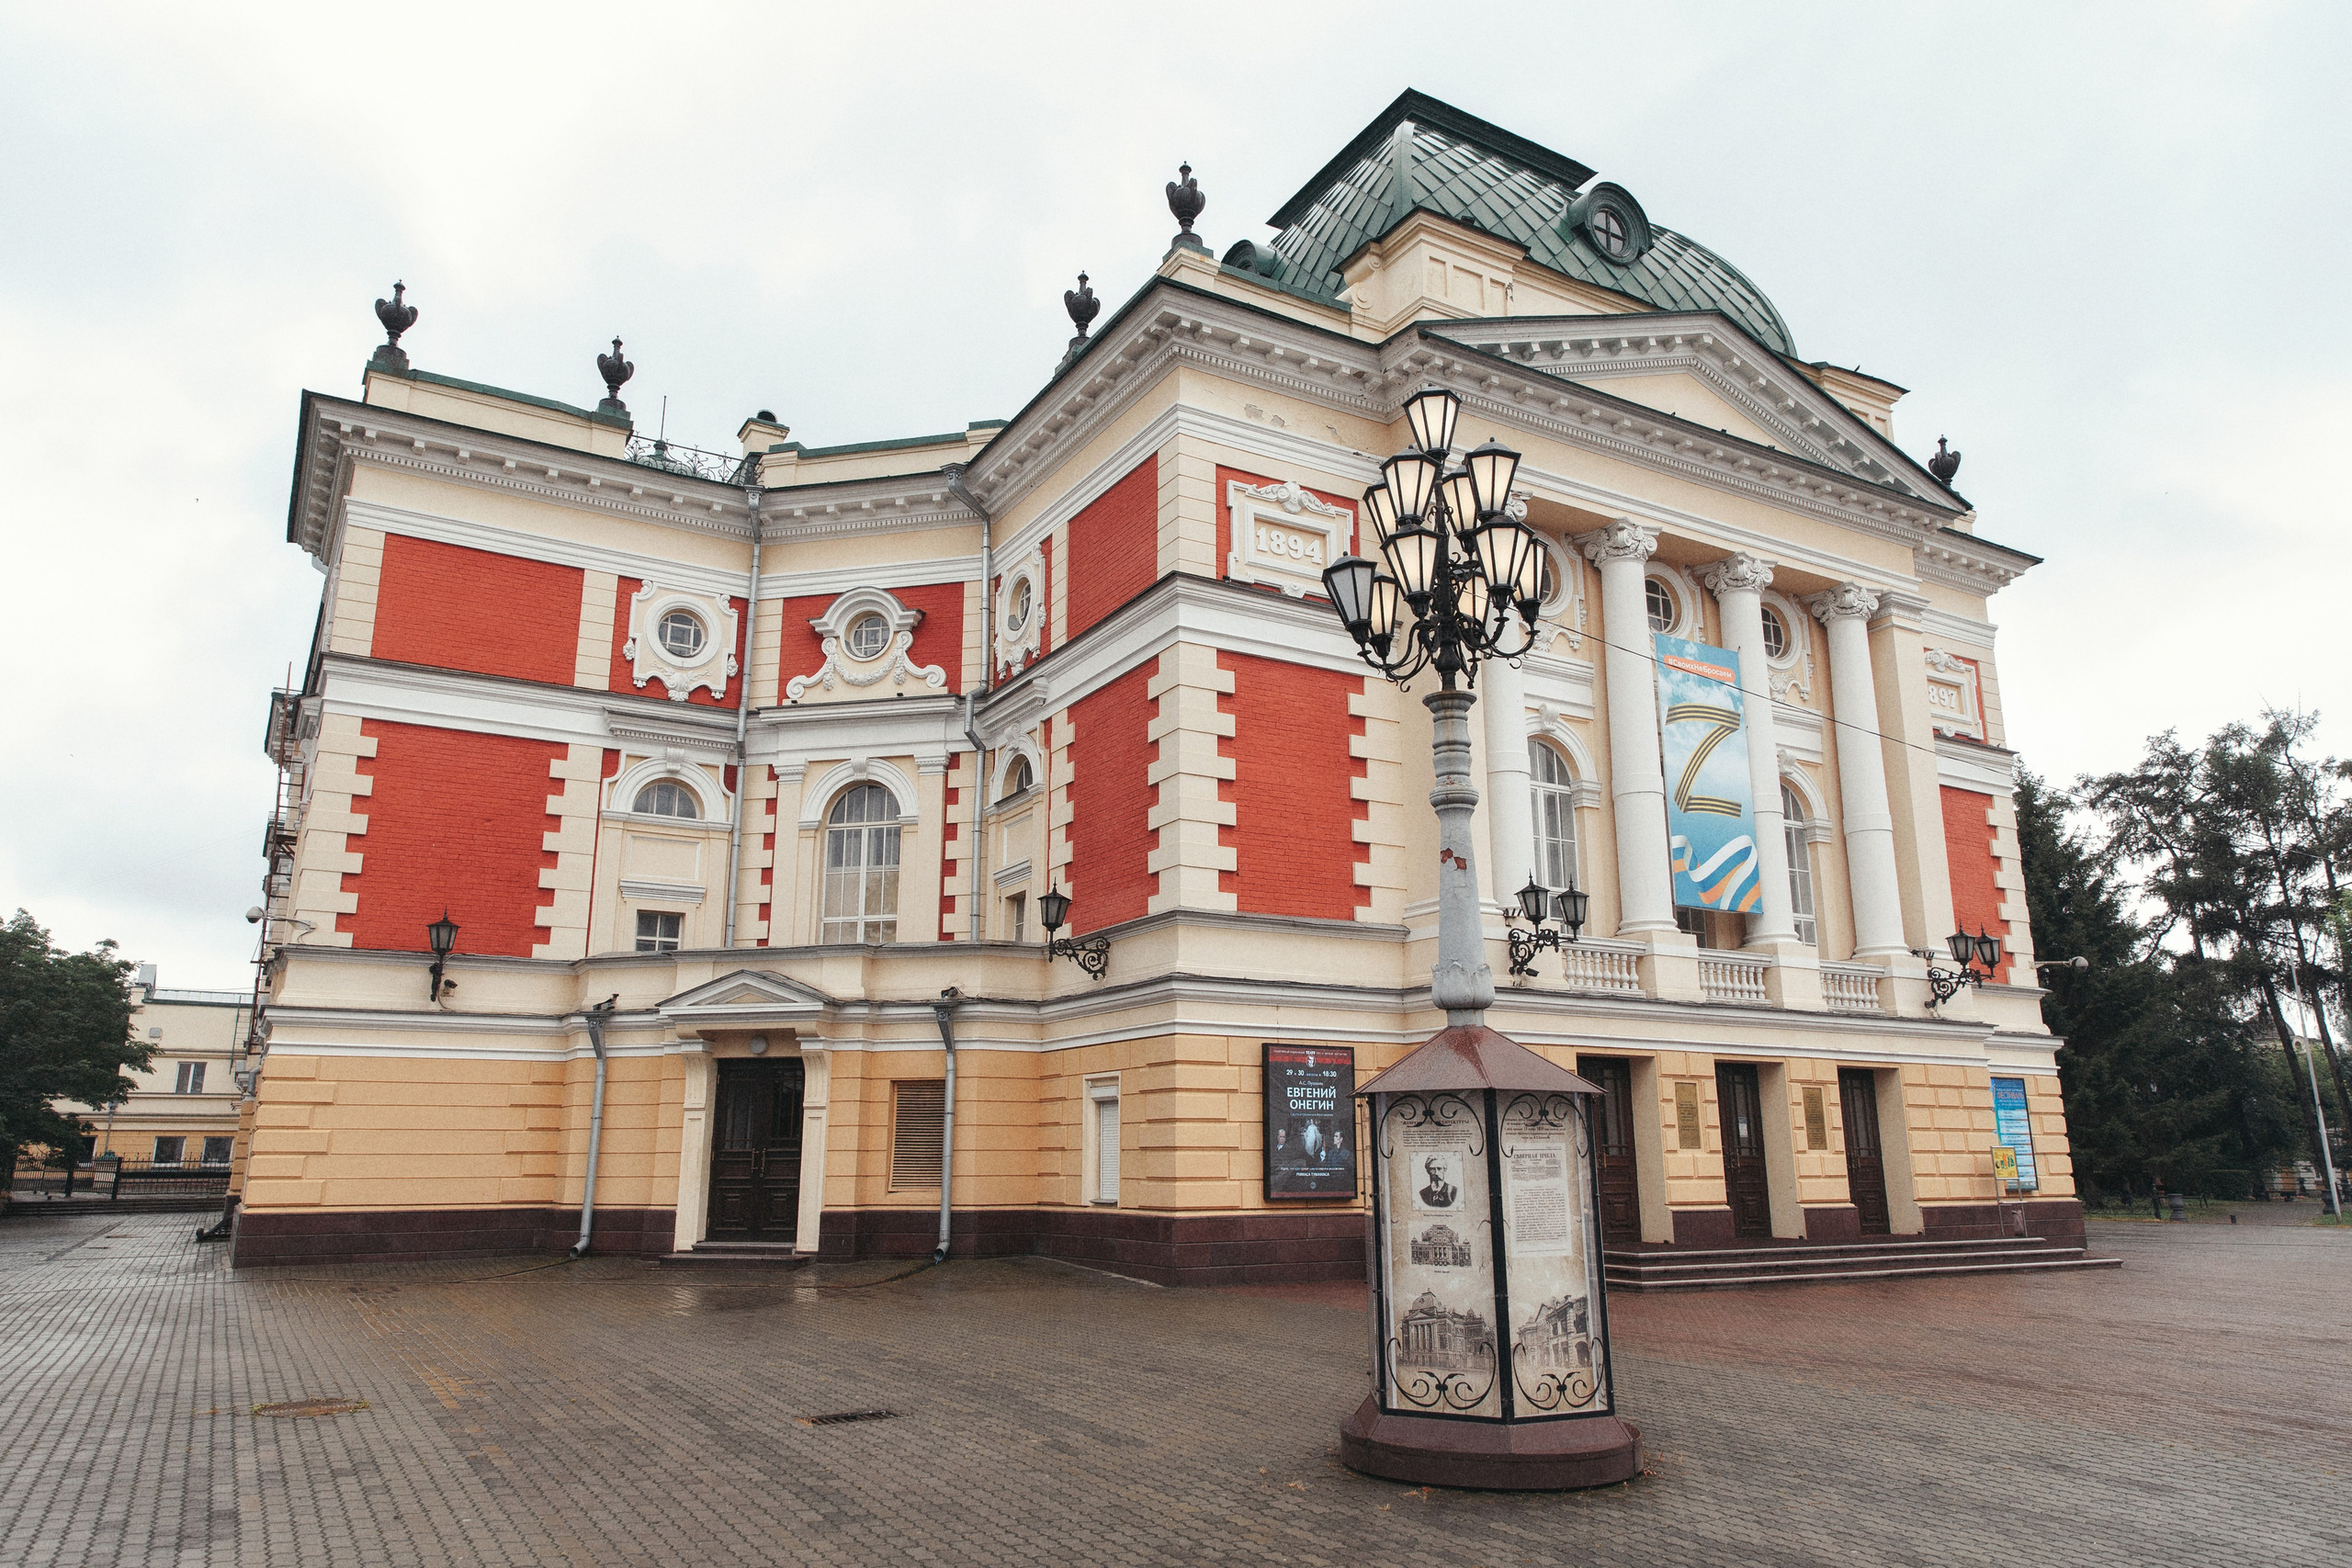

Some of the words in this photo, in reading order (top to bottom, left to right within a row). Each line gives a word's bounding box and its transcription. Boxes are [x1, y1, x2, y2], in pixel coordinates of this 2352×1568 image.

[1255, 527, 1323, 565] 1894
[1668, 658, 1733, 679] #СвоихНеБросаем
[1928, 684, 1958, 708] 897
[1286, 1086, 1337, 1099] ЕВГЕНИЙ
[1289, 1099, 1334, 1111] ОНЕГИН
